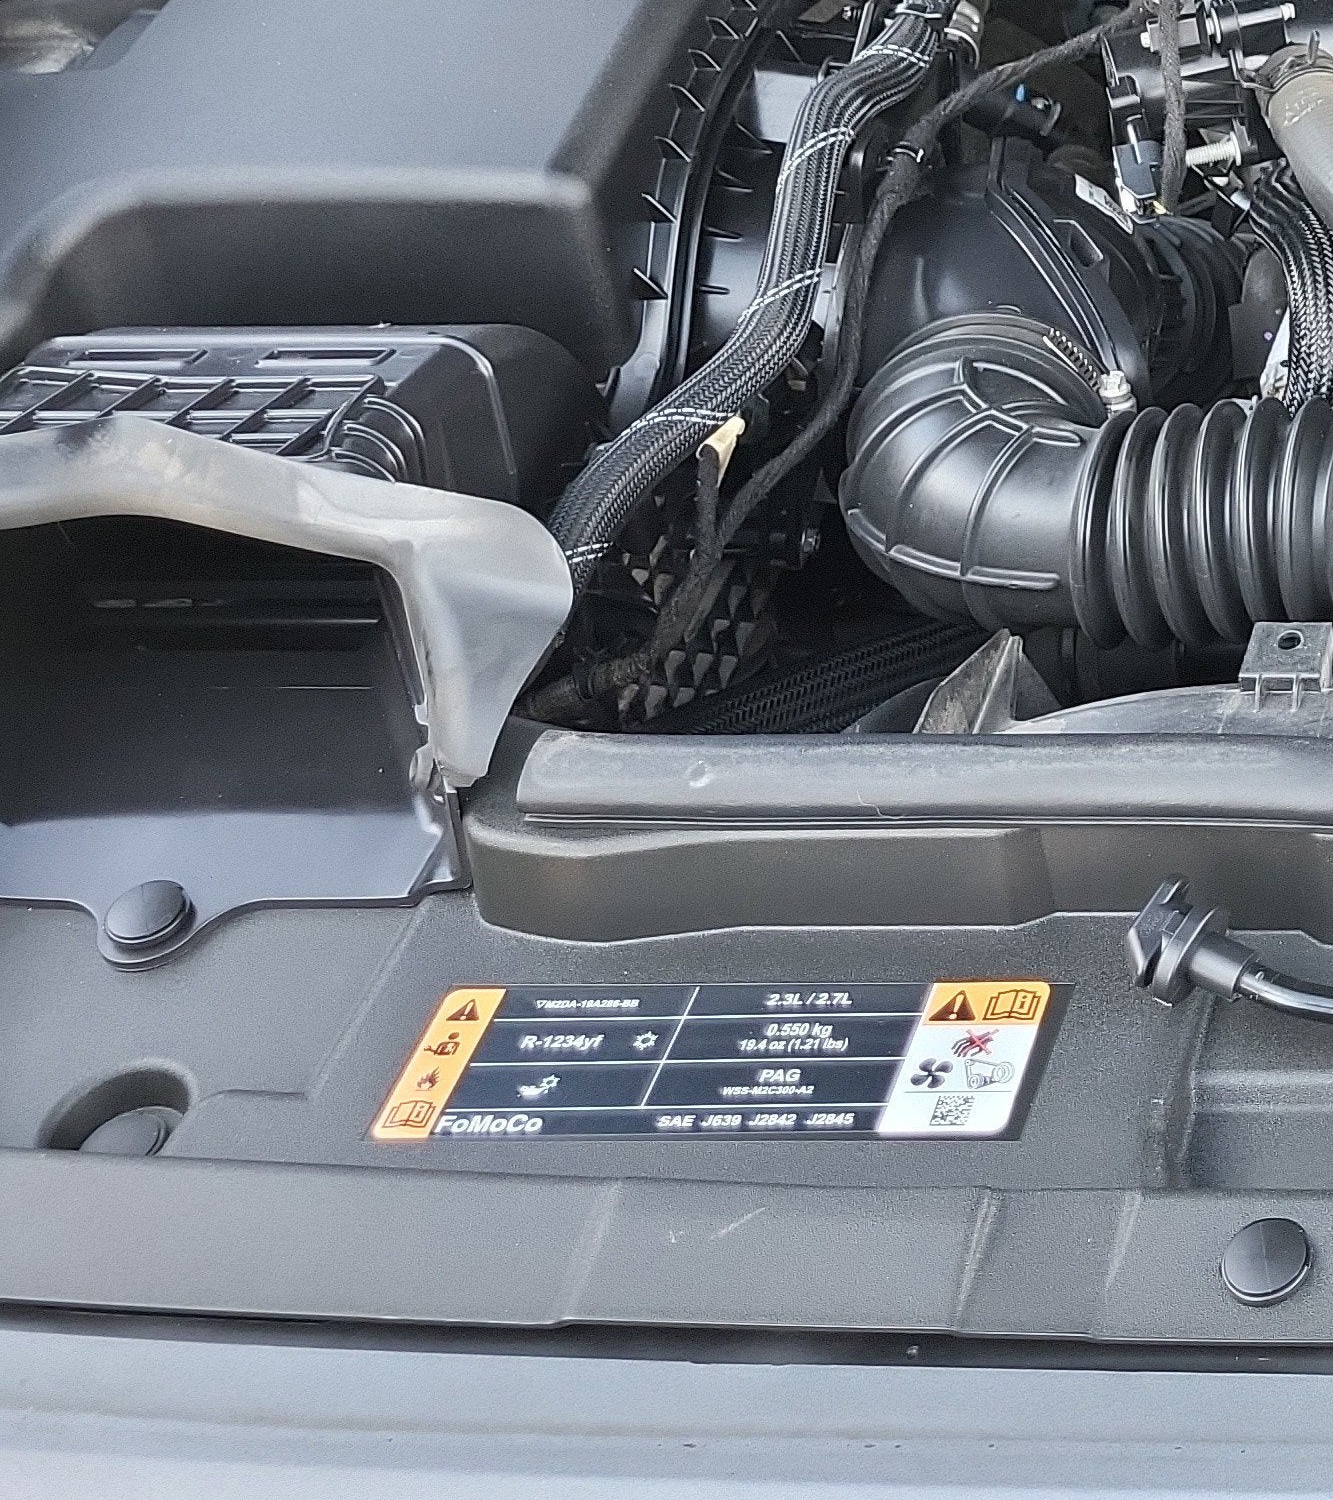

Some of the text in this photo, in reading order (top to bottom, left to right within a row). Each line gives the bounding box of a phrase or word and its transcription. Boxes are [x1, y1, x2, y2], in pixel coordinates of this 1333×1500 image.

[766, 993, 804, 1006] 2.3L
[816, 992, 853, 1005] 2.7L
[766, 1022, 834, 1039] 0.550 kg
[520, 1034, 605, 1051] R-1234yf
[739, 1037, 849, 1052] 19.4 oz (1.21 lbs)
[759, 1068, 802, 1083] PAG
[435, 1114, 544, 1135] FoMoCo
[658, 1112, 856, 1128] SAE J639 J2842 J2845
